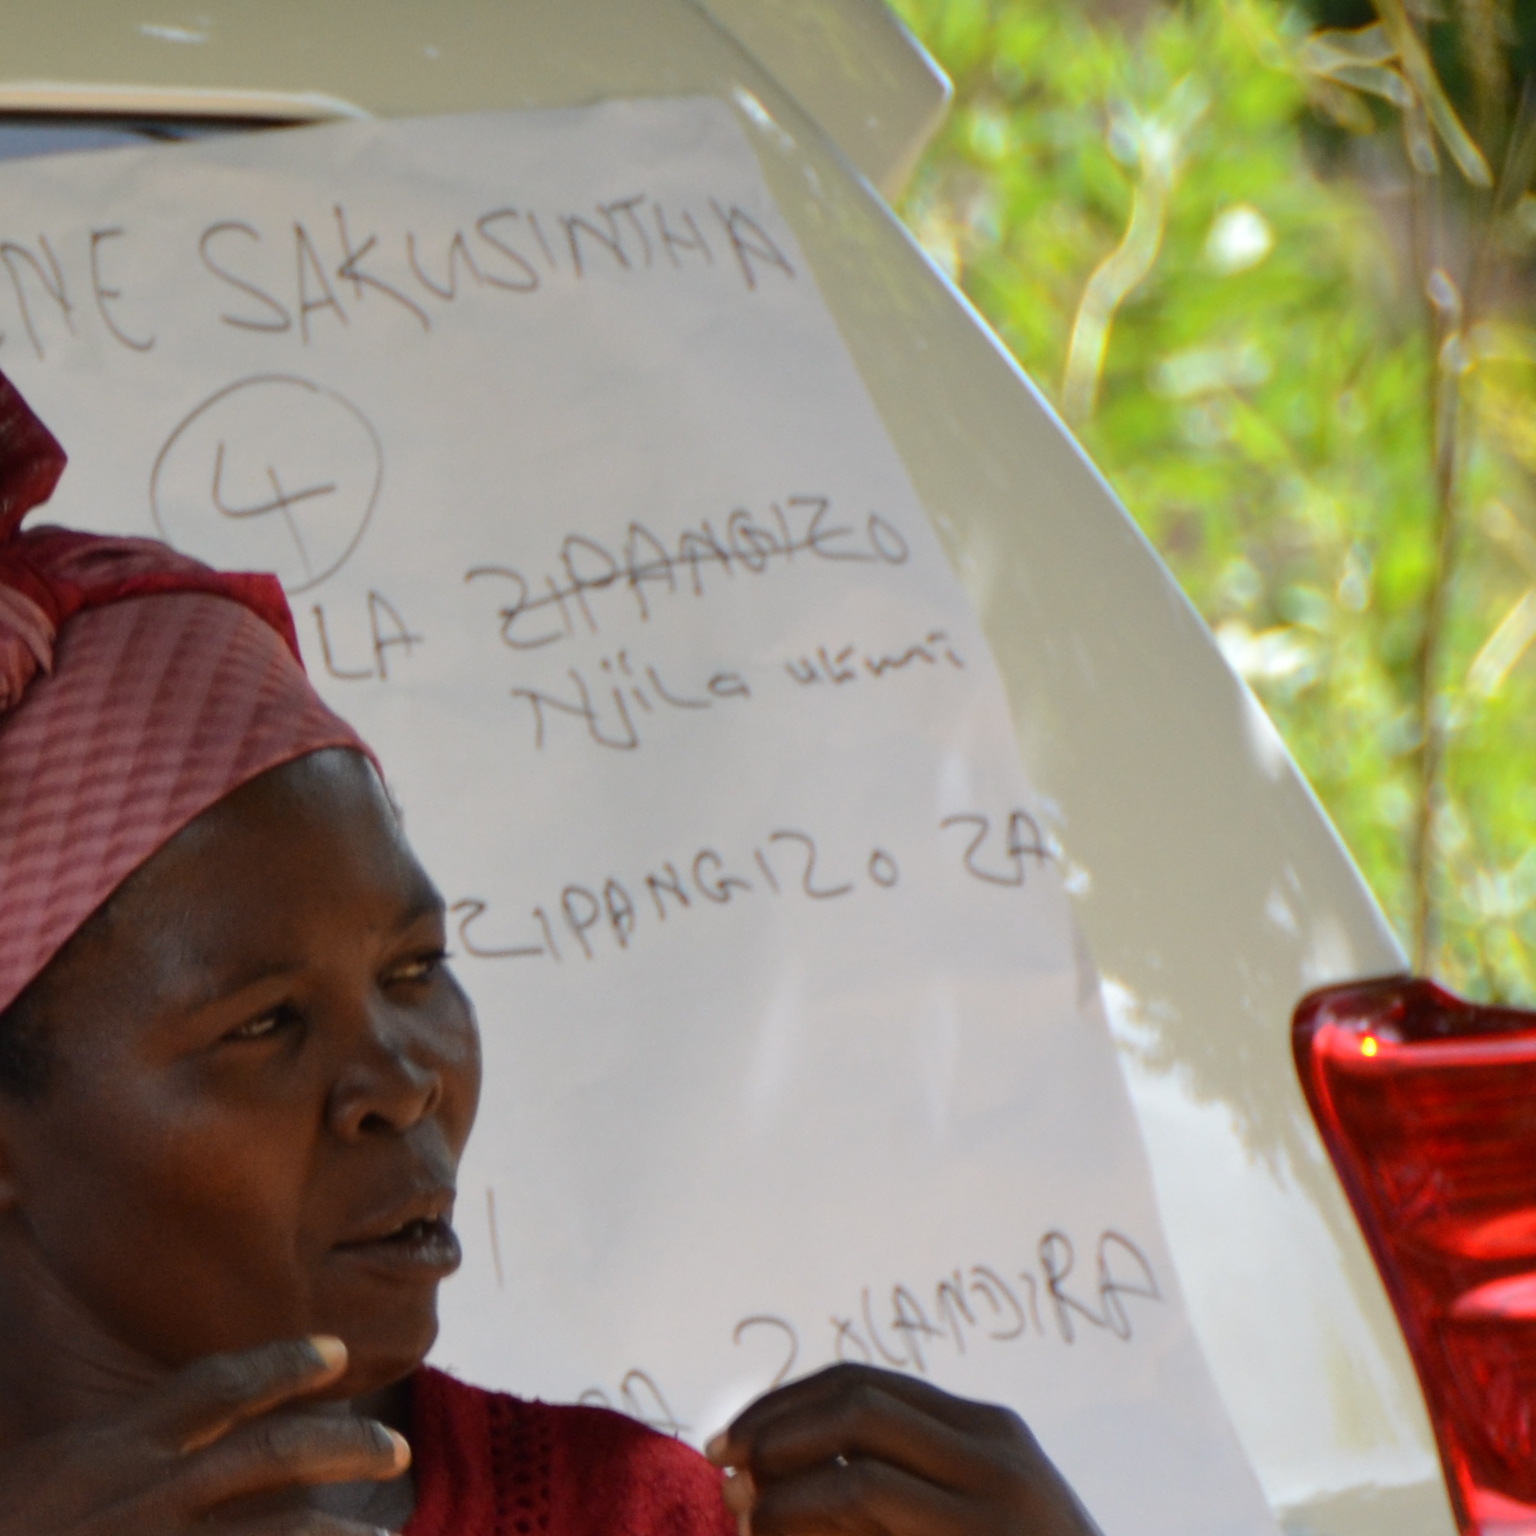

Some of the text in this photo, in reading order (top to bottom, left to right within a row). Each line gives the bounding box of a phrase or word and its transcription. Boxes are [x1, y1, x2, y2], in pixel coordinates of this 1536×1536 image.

[198, 195, 798, 350] SAKUSINTHA
[213, 440, 337, 585] 4
[450, 828, 901, 962] ZIPANGIZO
